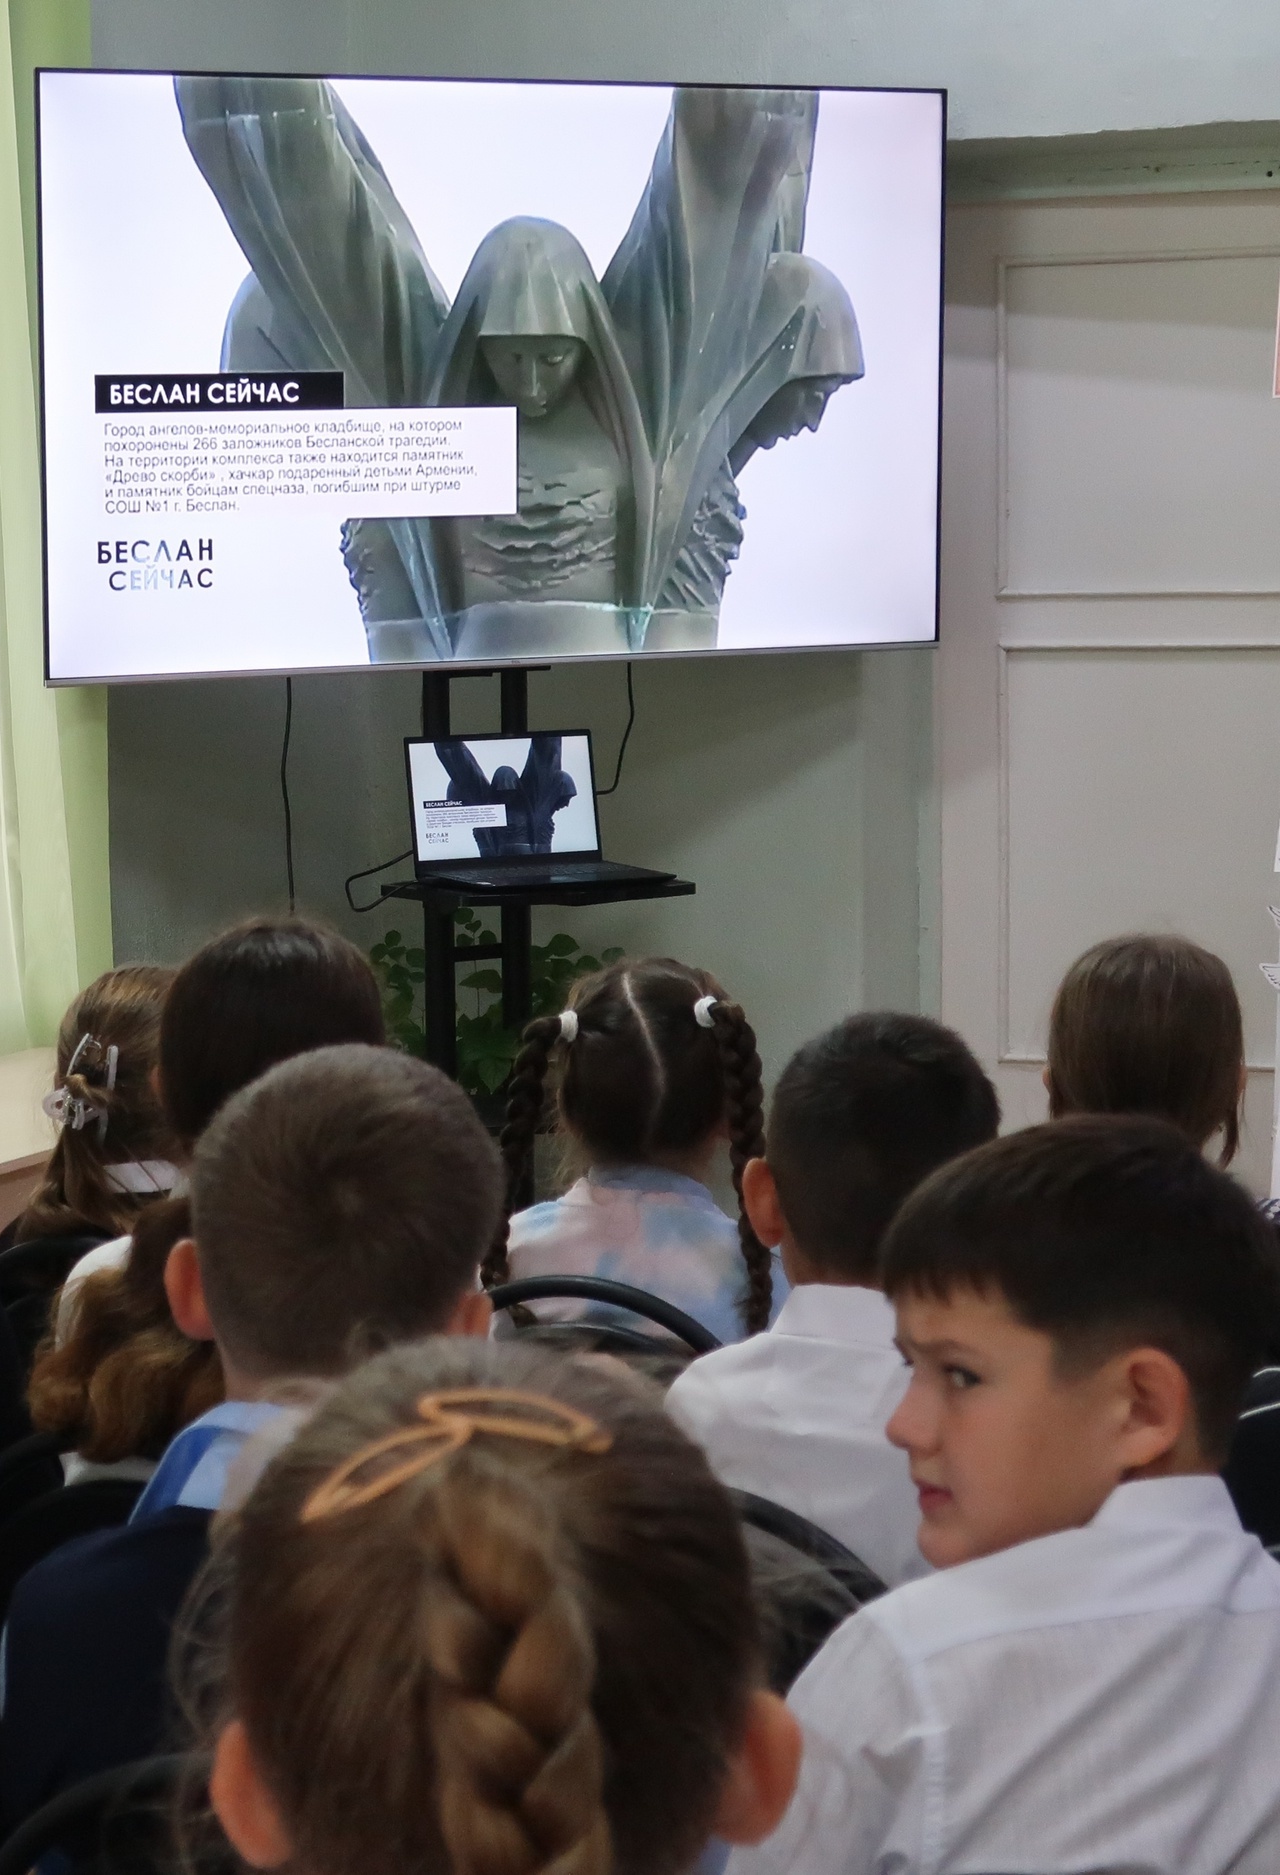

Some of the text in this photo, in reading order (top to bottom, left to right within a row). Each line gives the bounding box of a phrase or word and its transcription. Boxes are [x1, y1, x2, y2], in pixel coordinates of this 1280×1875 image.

[110, 378, 300, 405] БЕСЛАН СЕЙЧАС
[104, 419, 462, 438] Город ангелов-мемориальное кладбище, на котором
[104, 435, 450, 454] похоронены 266 заложников Бесланской трагедии.
[104, 450, 463, 469] На территории комплекса также находится памятник
[105, 469, 156, 485] «Древо
[160, 467, 216, 483] скорби»
[228, 469, 274, 482] хачкар
[278, 465, 361, 481] подаренный
[364, 466, 412, 478] детьми
[416, 464, 477, 478] Армении,
[105, 480, 461, 498] и памятник бойцам спецназа, погибшим при штурме
[105, 499, 240, 514] СОШ №1 г. Беслан.
[98, 538, 212, 564] БЕСЛАН
[109, 564, 213, 591] СЕЙЧАС
